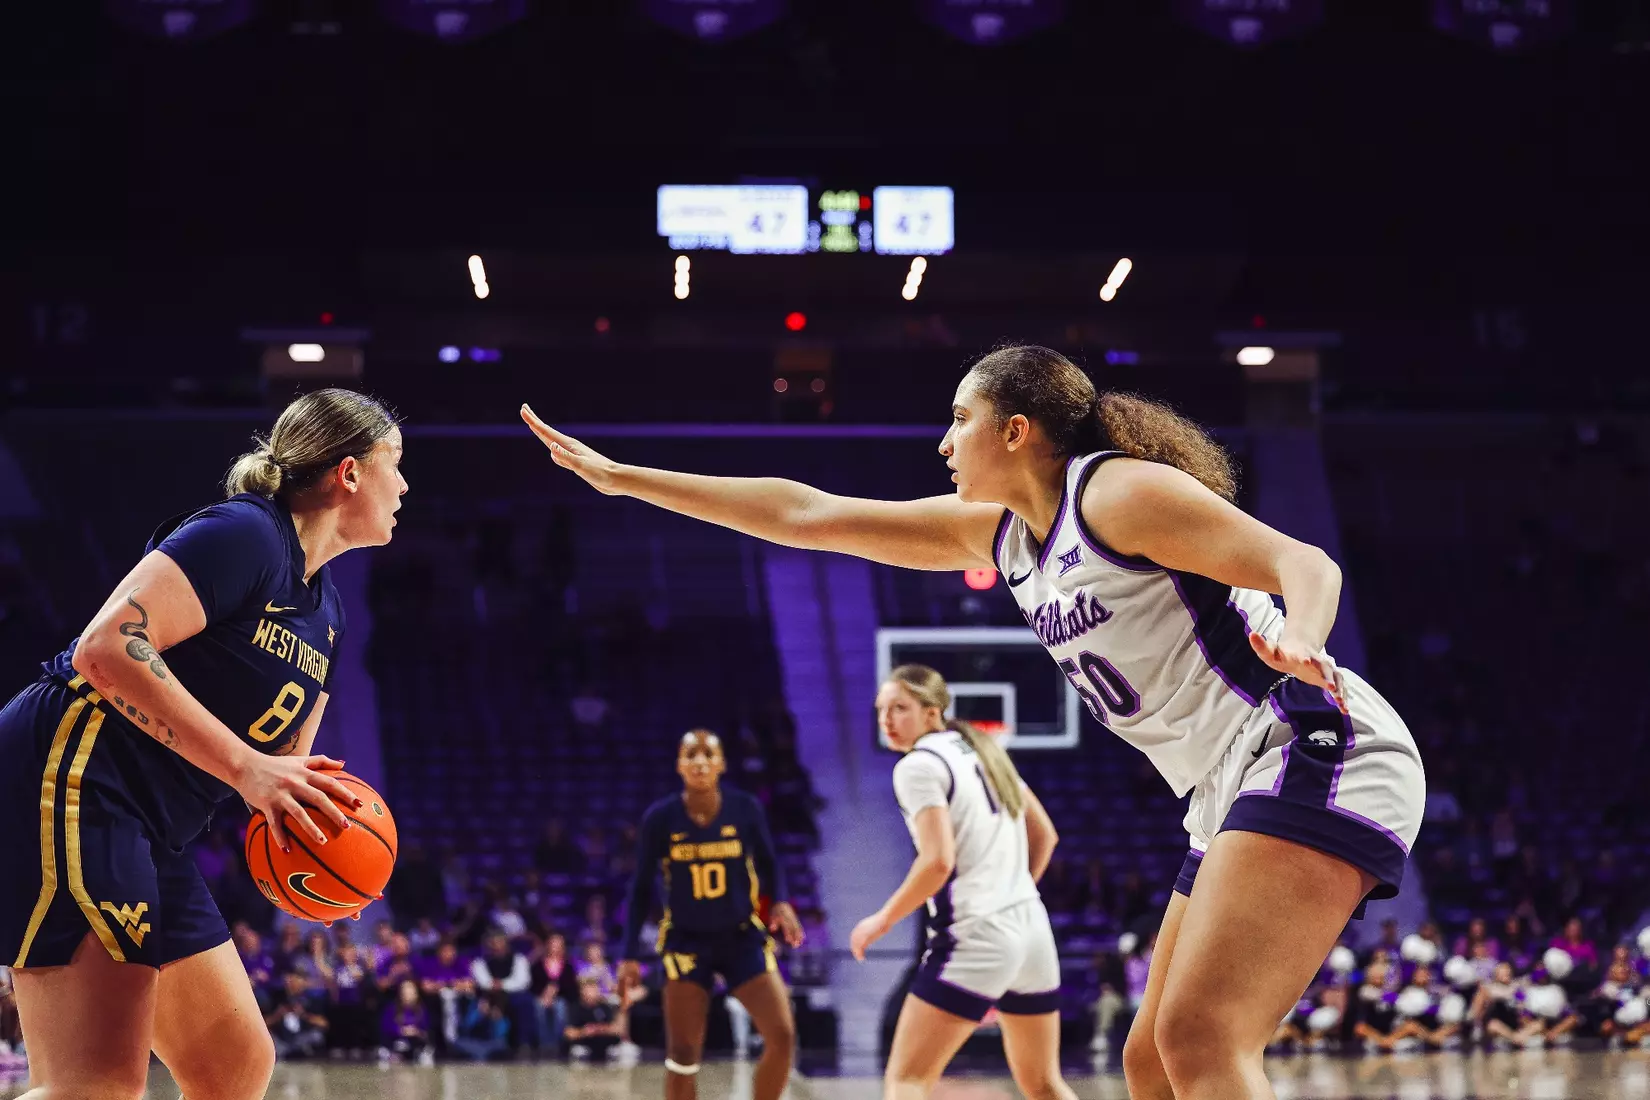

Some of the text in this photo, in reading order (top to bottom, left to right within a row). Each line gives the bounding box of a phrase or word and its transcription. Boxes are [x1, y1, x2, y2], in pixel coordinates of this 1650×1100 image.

[252, 618, 298, 663] WEST
[1020, 588, 1114, 648] Wildcats
[248, 681, 305, 743] 8
[1057, 650, 1141, 726] 50
[689, 862, 727, 900] 10
